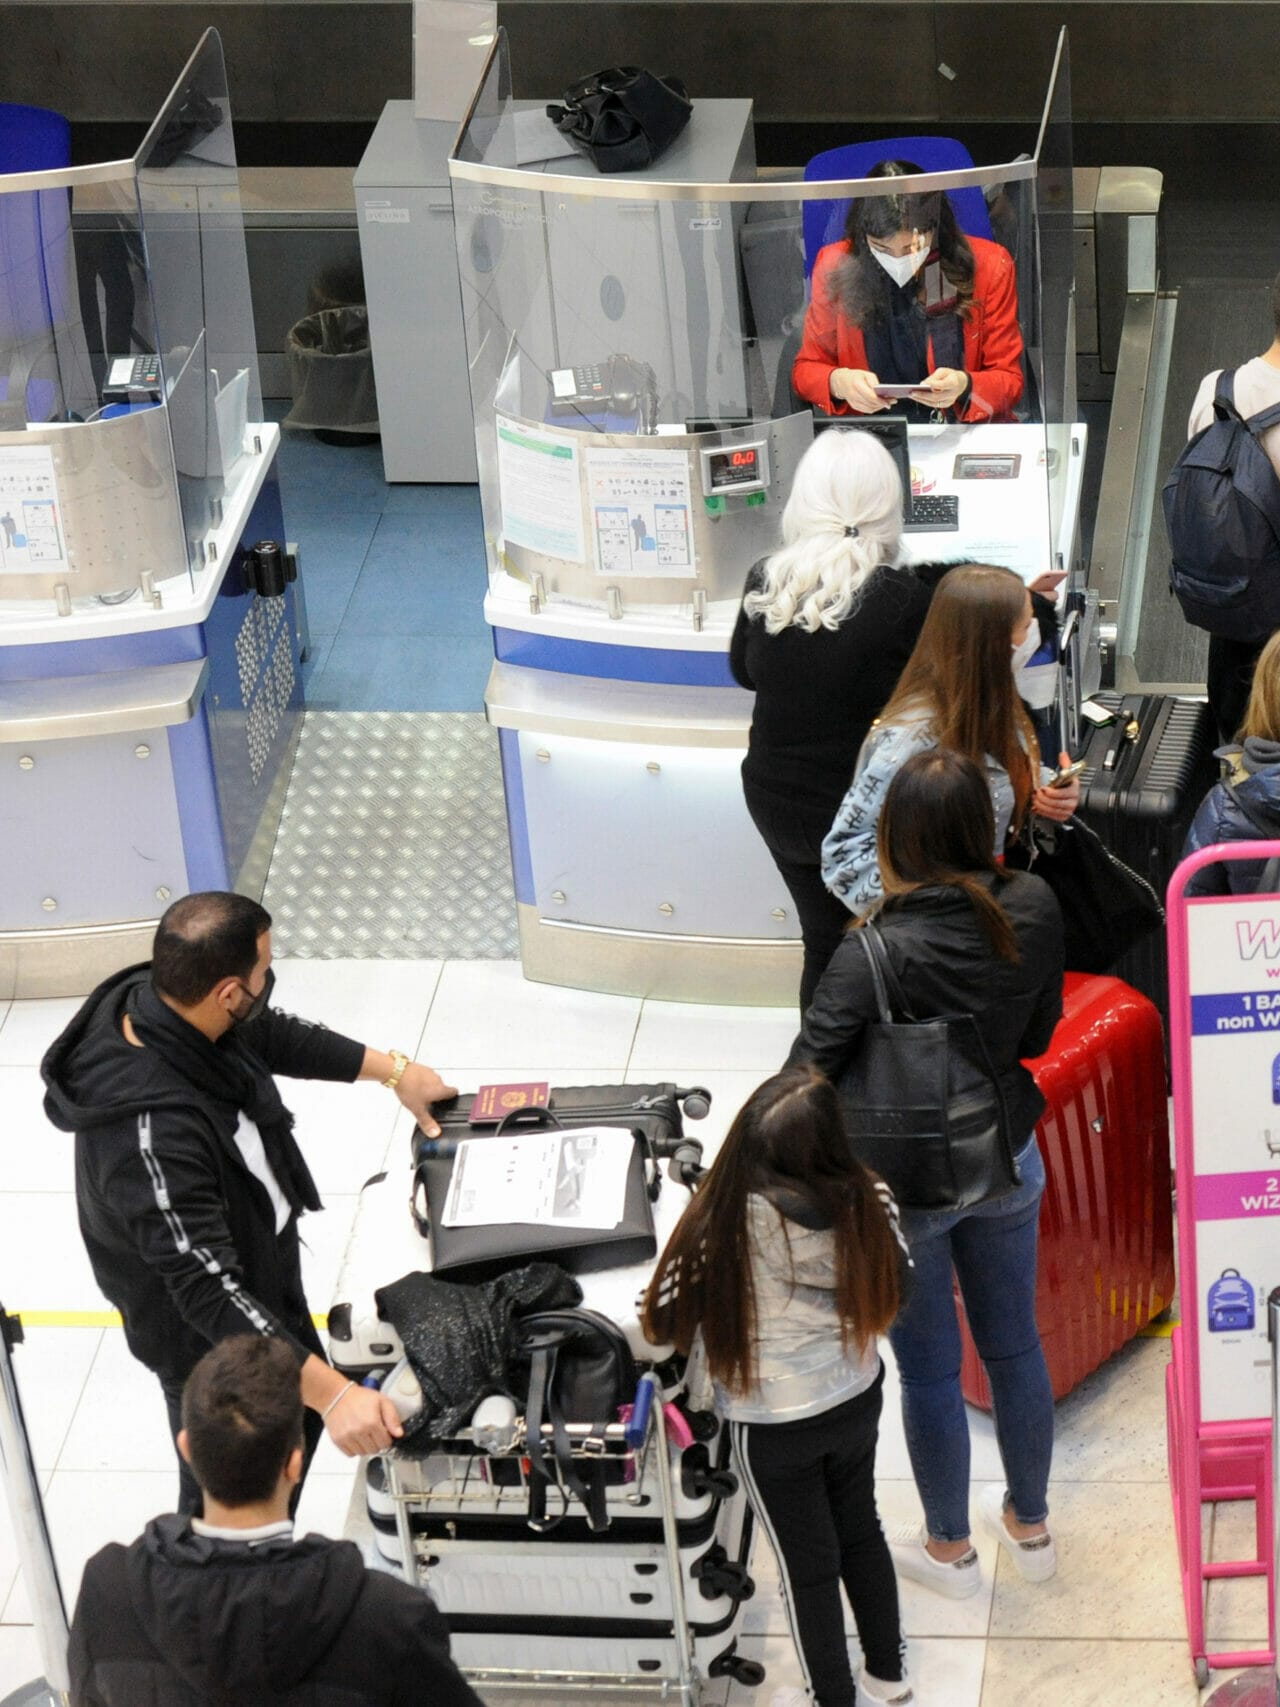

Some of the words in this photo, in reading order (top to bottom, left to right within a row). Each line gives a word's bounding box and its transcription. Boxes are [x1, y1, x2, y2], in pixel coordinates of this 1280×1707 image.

[732, 449, 756, 467] 0.0
[1243, 995, 1252, 1010] 1
[1216, 1015, 1255, 1030] non
[1266, 1177, 1278, 1192] 2
